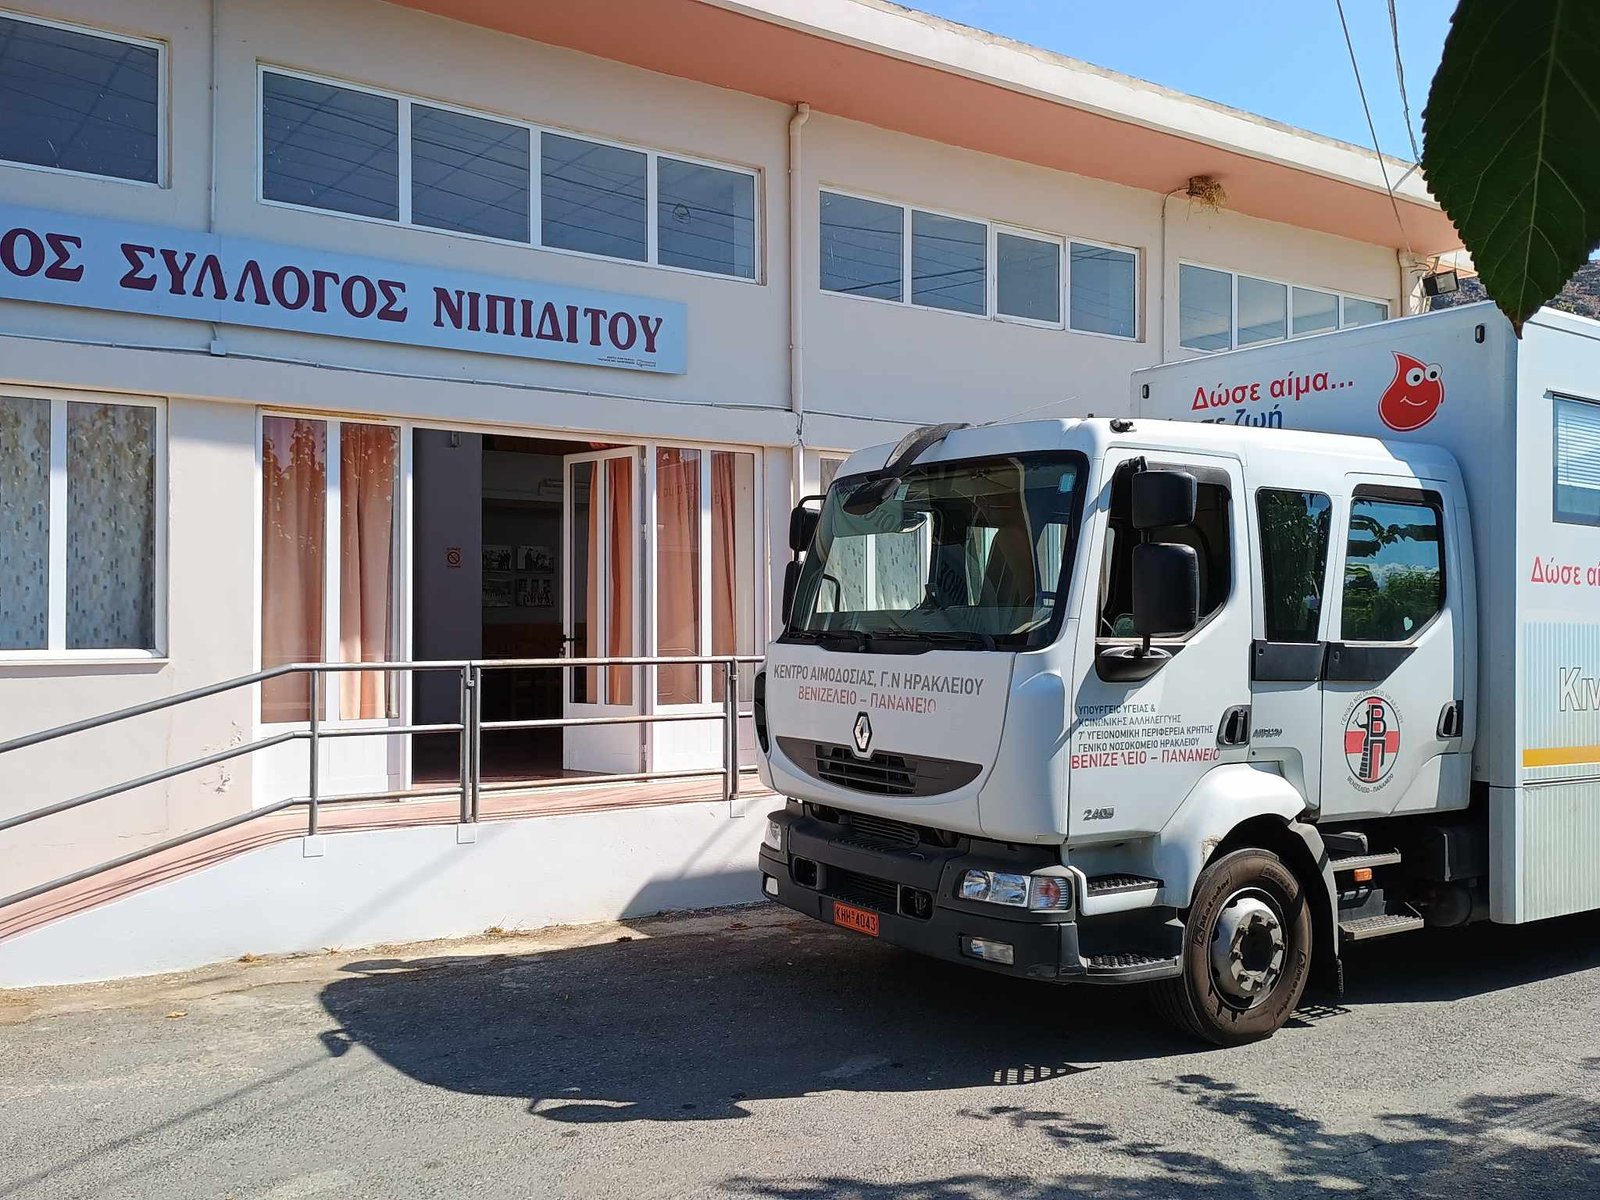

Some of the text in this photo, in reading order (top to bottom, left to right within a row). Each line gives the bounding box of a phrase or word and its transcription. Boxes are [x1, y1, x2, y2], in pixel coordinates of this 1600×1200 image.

[120, 243, 408, 322] ΣΥΛΛΟΓΟΣ
[433, 286, 663, 353] ΝΙΠΙΔΙΤΟΥ
[1191, 371, 1353, 410] Δώσε αίμα...
[1530, 556, 1581, 585] Δώσε
[774, 664, 809, 680] ΚΕΝΤΡΟ
[810, 666, 877, 688] ΑΙΜΟΔΟΣΙΑΣ,
[904, 672, 984, 696] ΗΡΑΚΛΕΙΟΥ
[798, 685, 857, 705] ΒΕΝΙΖΕΛΕΙΟ
[870, 692, 937, 714] ΠΑΝΑΝΕΙΟ
[1123, 703, 1149, 714] ΥΓΕΙΑΣ
[1151, 703, 1156, 713] &
[1078, 737, 1200, 753] ΓΕΝΙΚΟ ΝΟΣΟΚΟΜΕΙΟ ΗΡΑΚΛΕΙΟΥ
[1087, 728, 1140, 740] ΥΓΕΙΟΝΟΜΙΚΗ
[1141, 726, 1185, 737] ΠΕΡΙΦΕΡΕΙΑ
[1186, 724, 1214, 735] ΚΡΗΤΗΣ
[1161, 748, 1220, 764] ΠΑΝΑΝΕΙΟ
